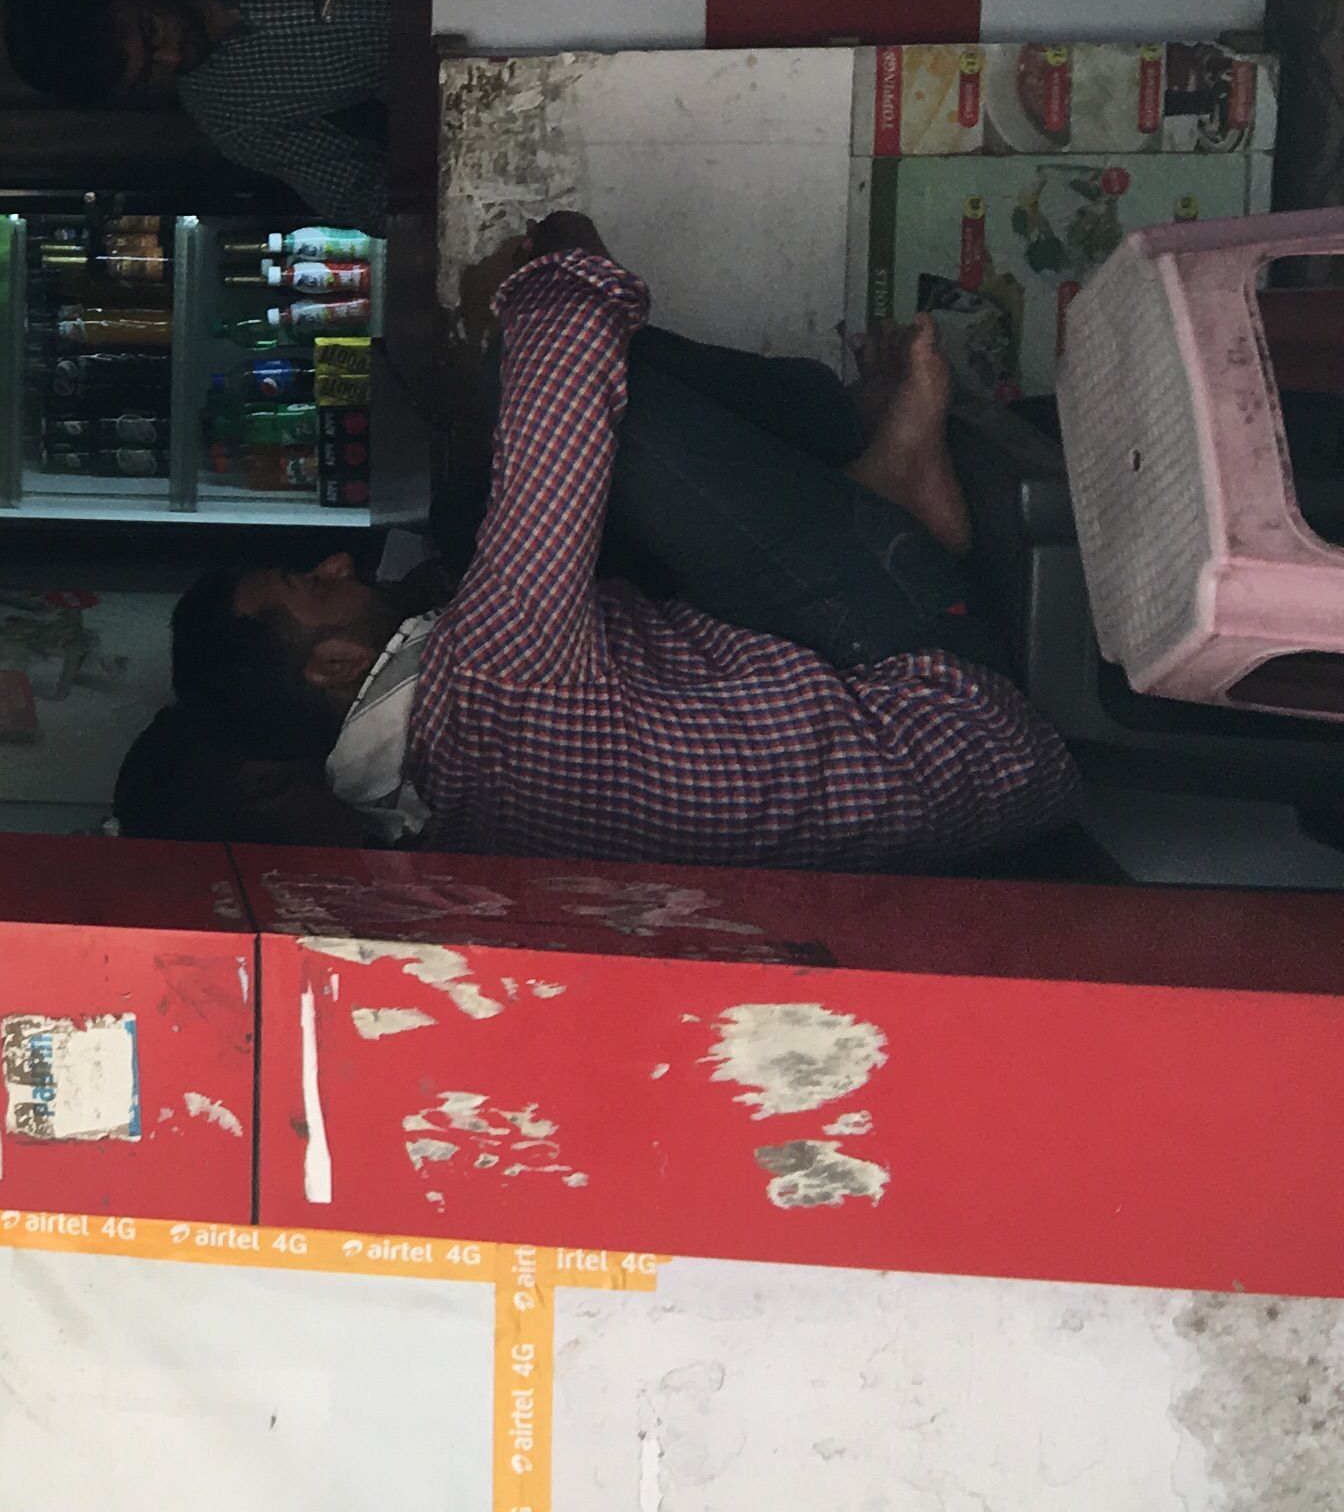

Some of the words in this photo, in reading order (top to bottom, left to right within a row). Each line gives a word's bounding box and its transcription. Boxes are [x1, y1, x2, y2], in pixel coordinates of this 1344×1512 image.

[24, 1211, 90, 1236] airtel
[100, 1216, 137, 1241] 4G
[195, 1223, 261, 1251] airtel
[270, 1231, 309, 1254] 4G
[365, 1239, 434, 1263] airtel
[444, 1244, 482, 1266] 4G
[620, 1252, 657, 1275] 4G
[511, 1344, 535, 1377] 4G
[508, 1387, 535, 1450] airtel
